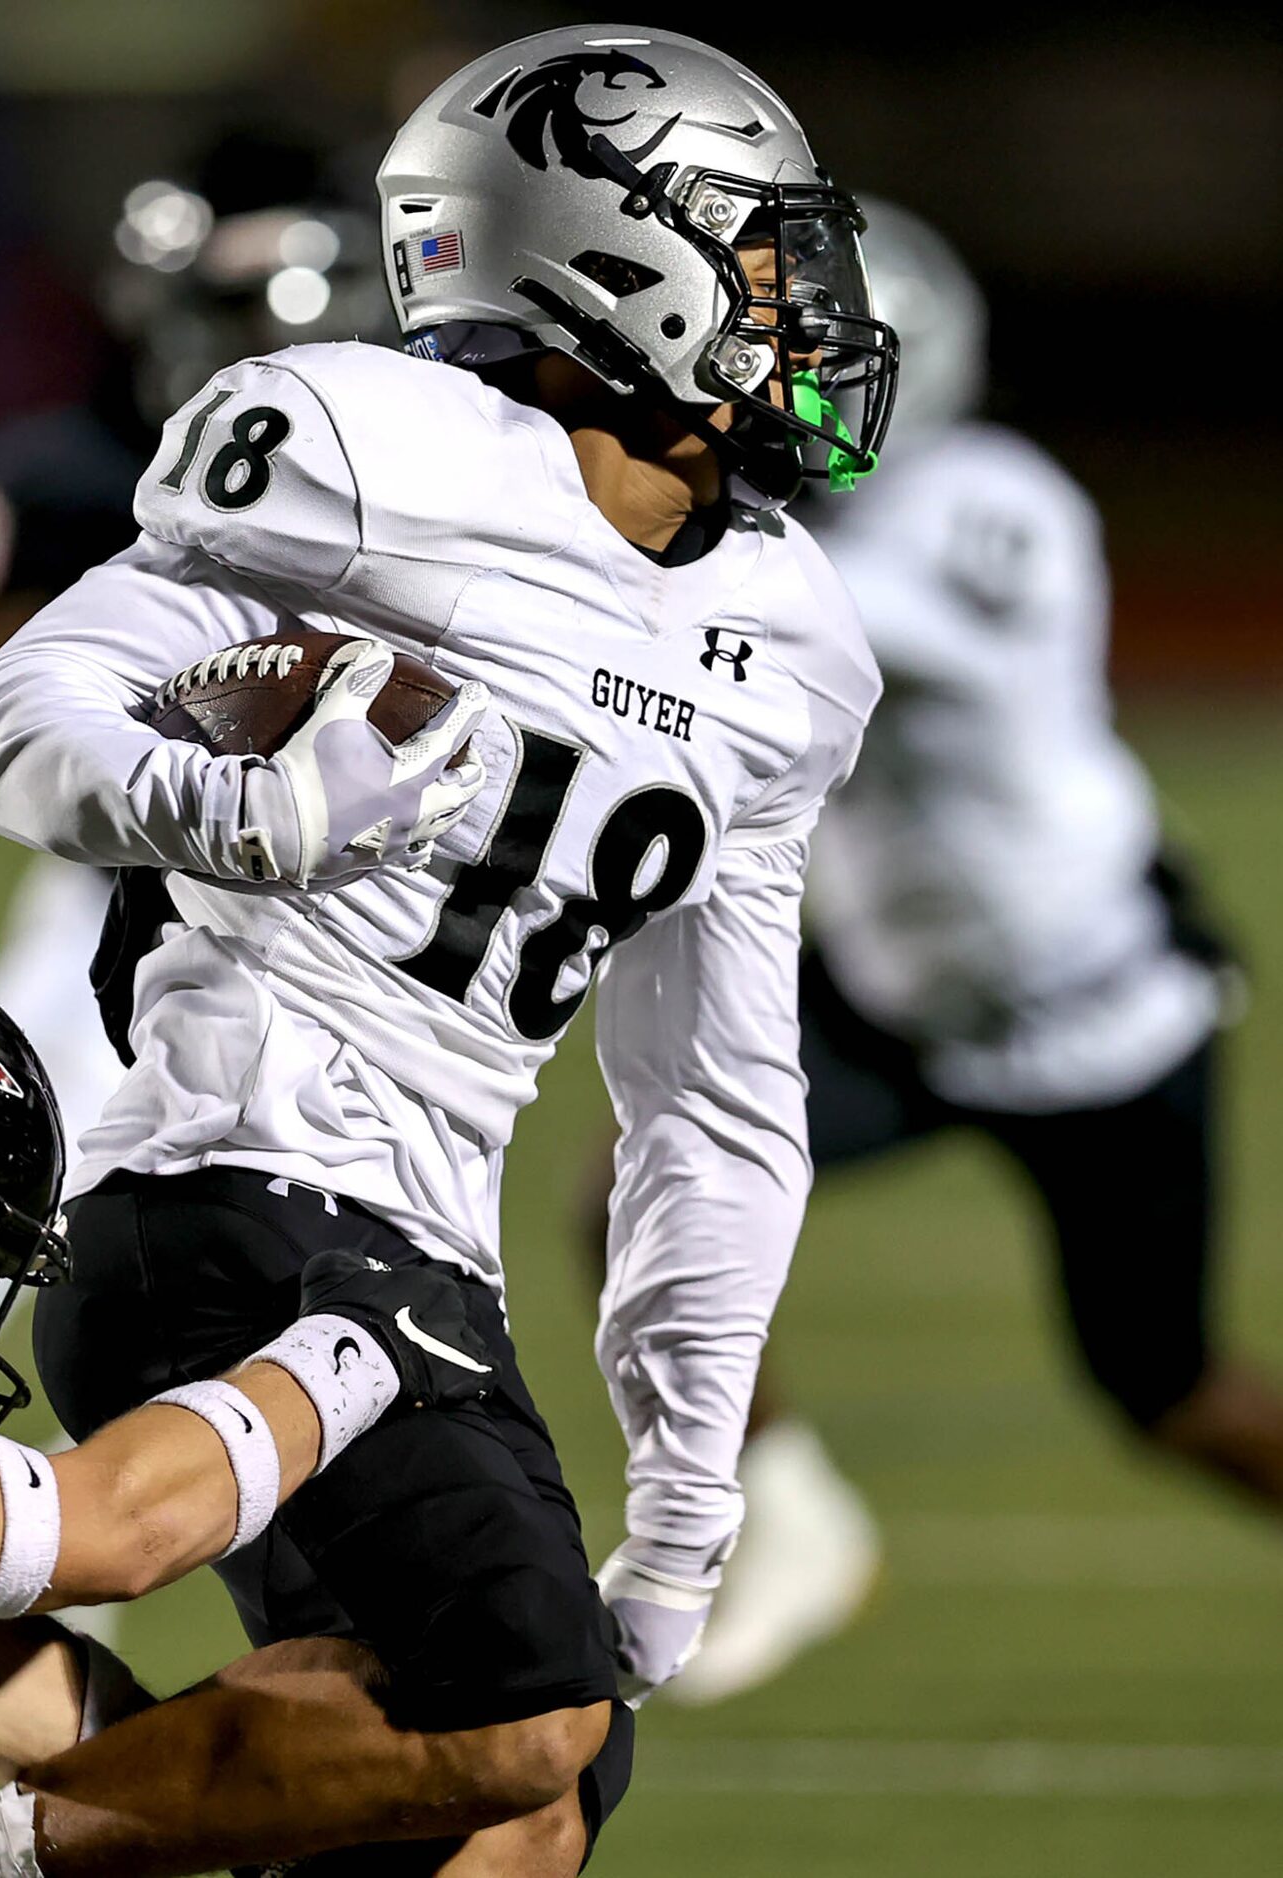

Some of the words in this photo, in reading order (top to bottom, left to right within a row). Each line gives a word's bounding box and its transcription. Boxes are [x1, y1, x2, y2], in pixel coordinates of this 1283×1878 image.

[158, 388, 293, 513] 18
[592, 668, 696, 742] GUYER
[383, 718, 711, 1044] 18
